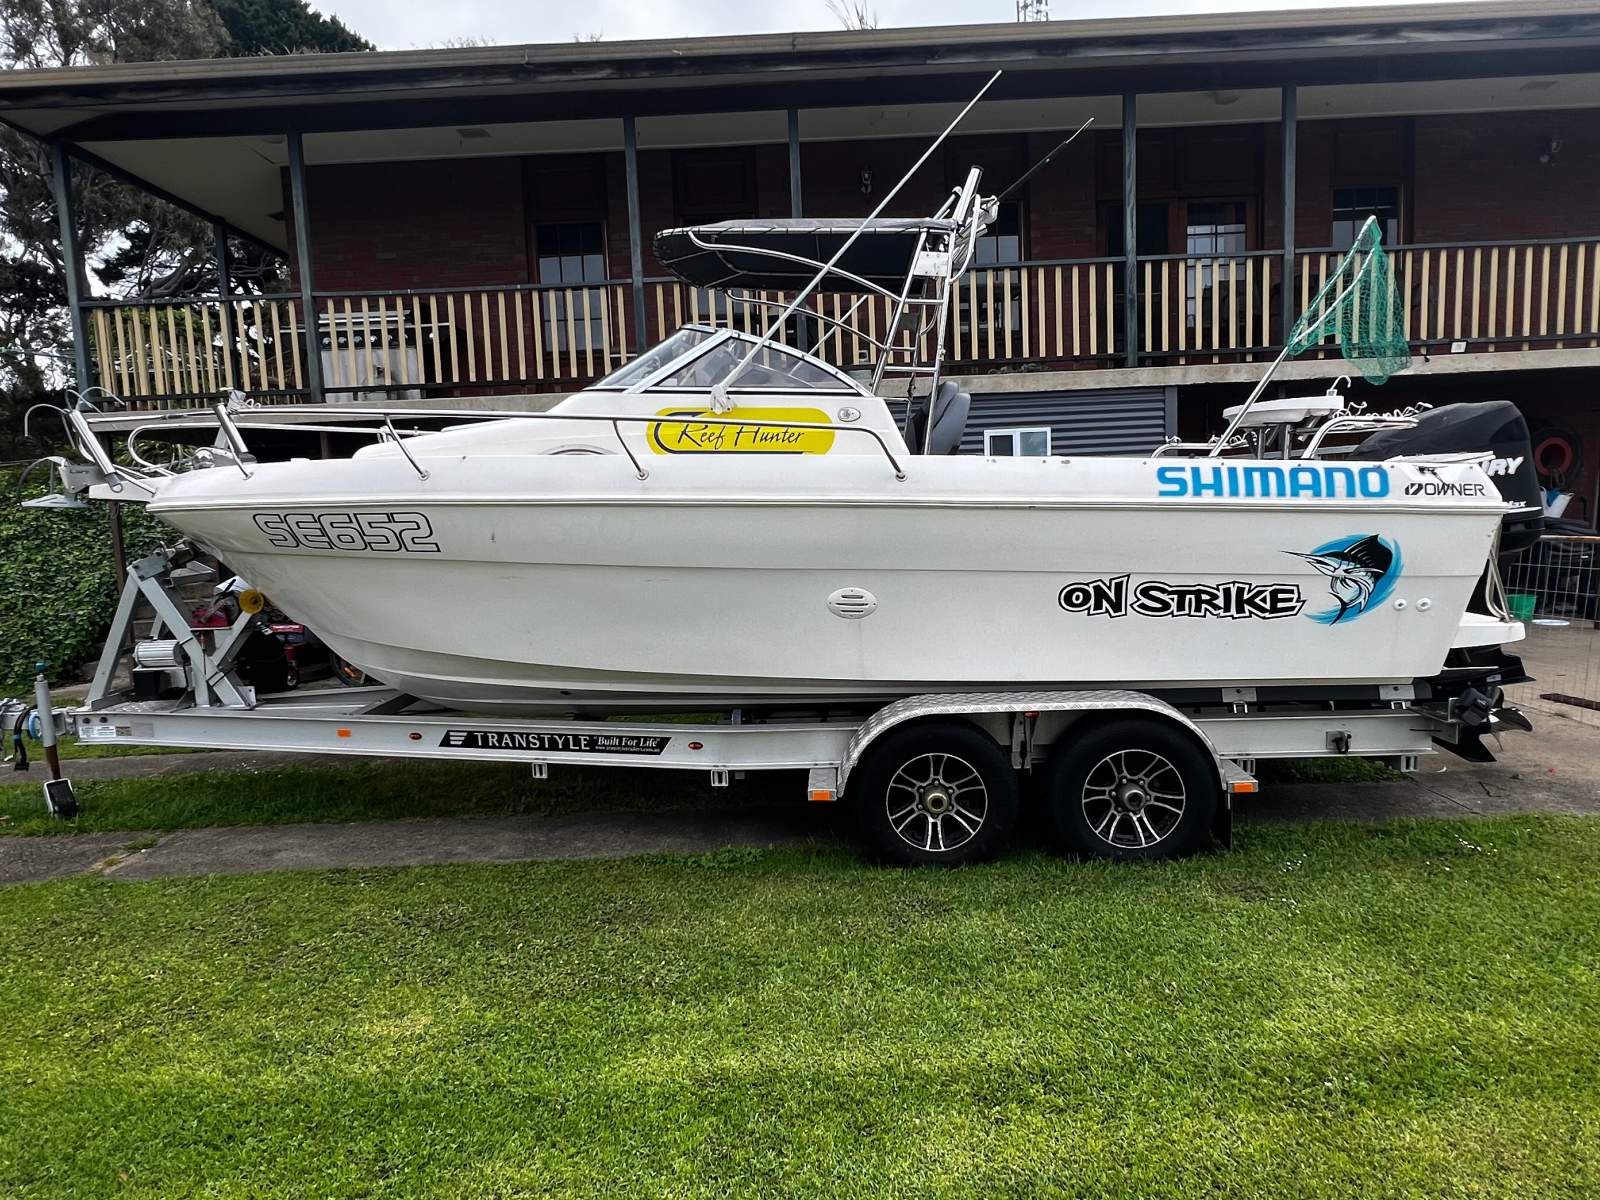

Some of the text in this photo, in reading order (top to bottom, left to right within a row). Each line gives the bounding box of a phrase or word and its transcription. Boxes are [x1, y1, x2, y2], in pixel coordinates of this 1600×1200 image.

[677, 424, 805, 450] Reef Hunter
[1156, 466, 1391, 498] SHIMANO
[1424, 482, 1486, 497] OWNER
[252, 511, 442, 553] SE652
[1058, 573, 1308, 620] ON STRIKE
[473, 732, 591, 750] TRANSTYLE
[621, 737, 638, 747] For
